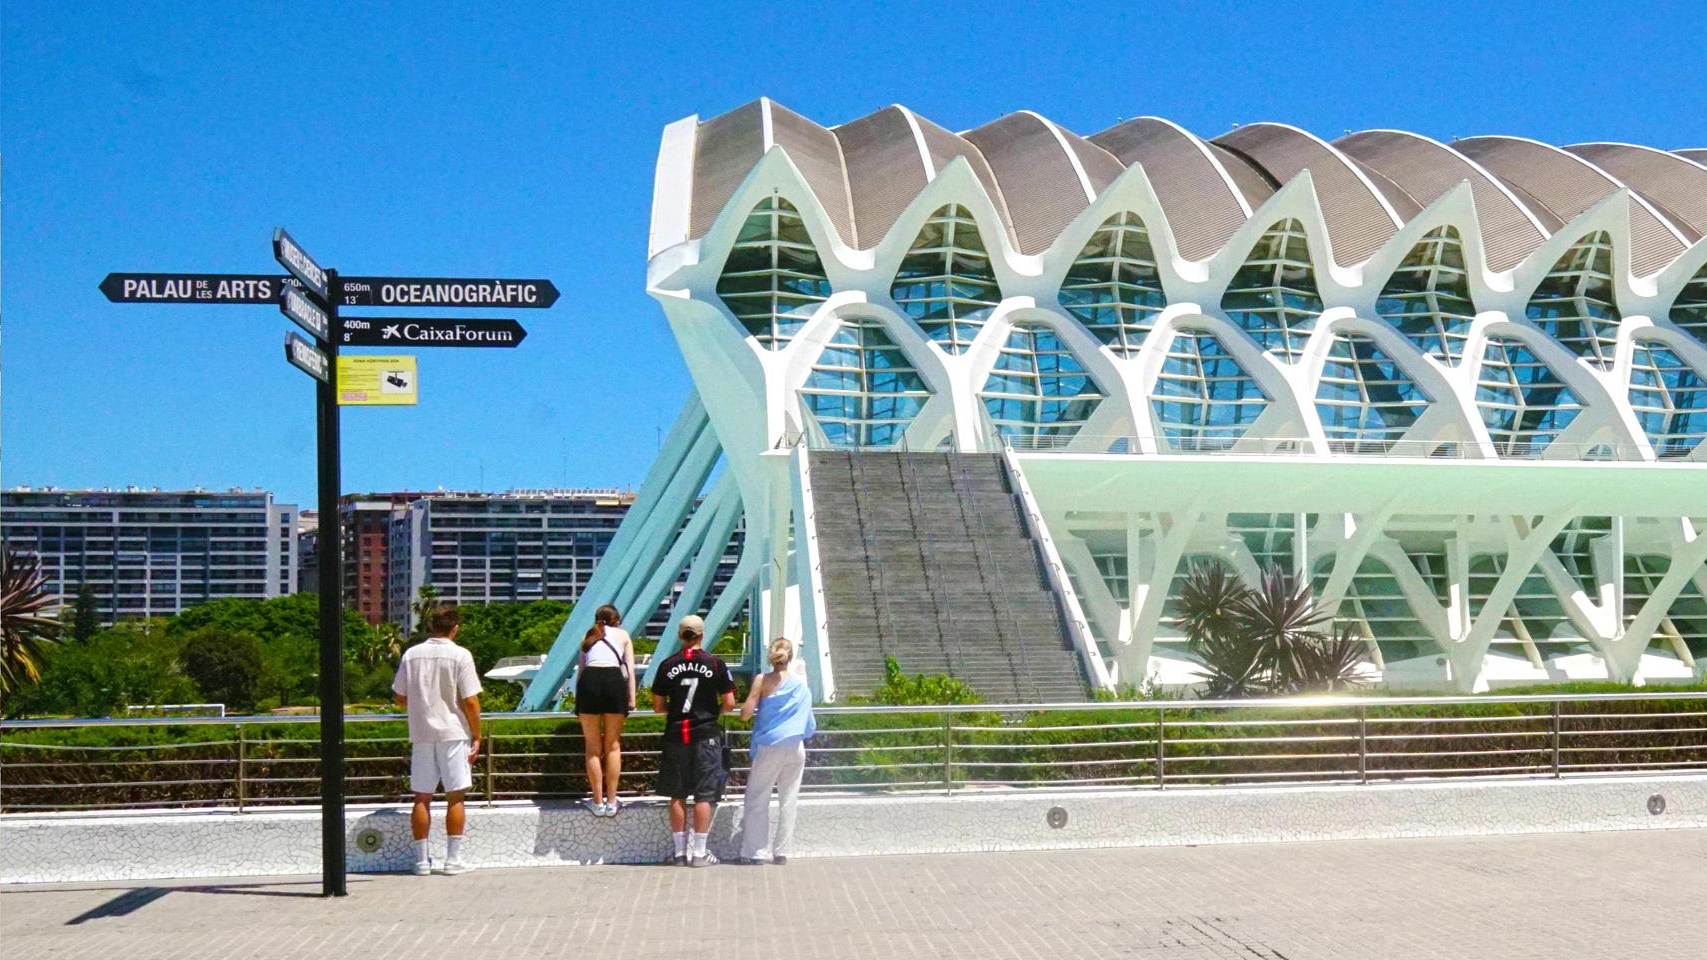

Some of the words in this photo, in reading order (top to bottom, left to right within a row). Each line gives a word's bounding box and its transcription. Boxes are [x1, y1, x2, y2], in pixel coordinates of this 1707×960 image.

[123, 279, 192, 298] PALAU
[196, 280, 208, 289] DE
[216, 280, 272, 299] ARTS
[344, 282, 371, 292] 650m
[381, 281, 537, 303] OCEANOGRÀFIC
[196, 290, 213, 299] LES
[344, 320, 371, 329] 400m
[404, 323, 513, 341] CaixaForum
[666, 662, 714, 680] RONALDO
[680, 677, 699, 713] 7
